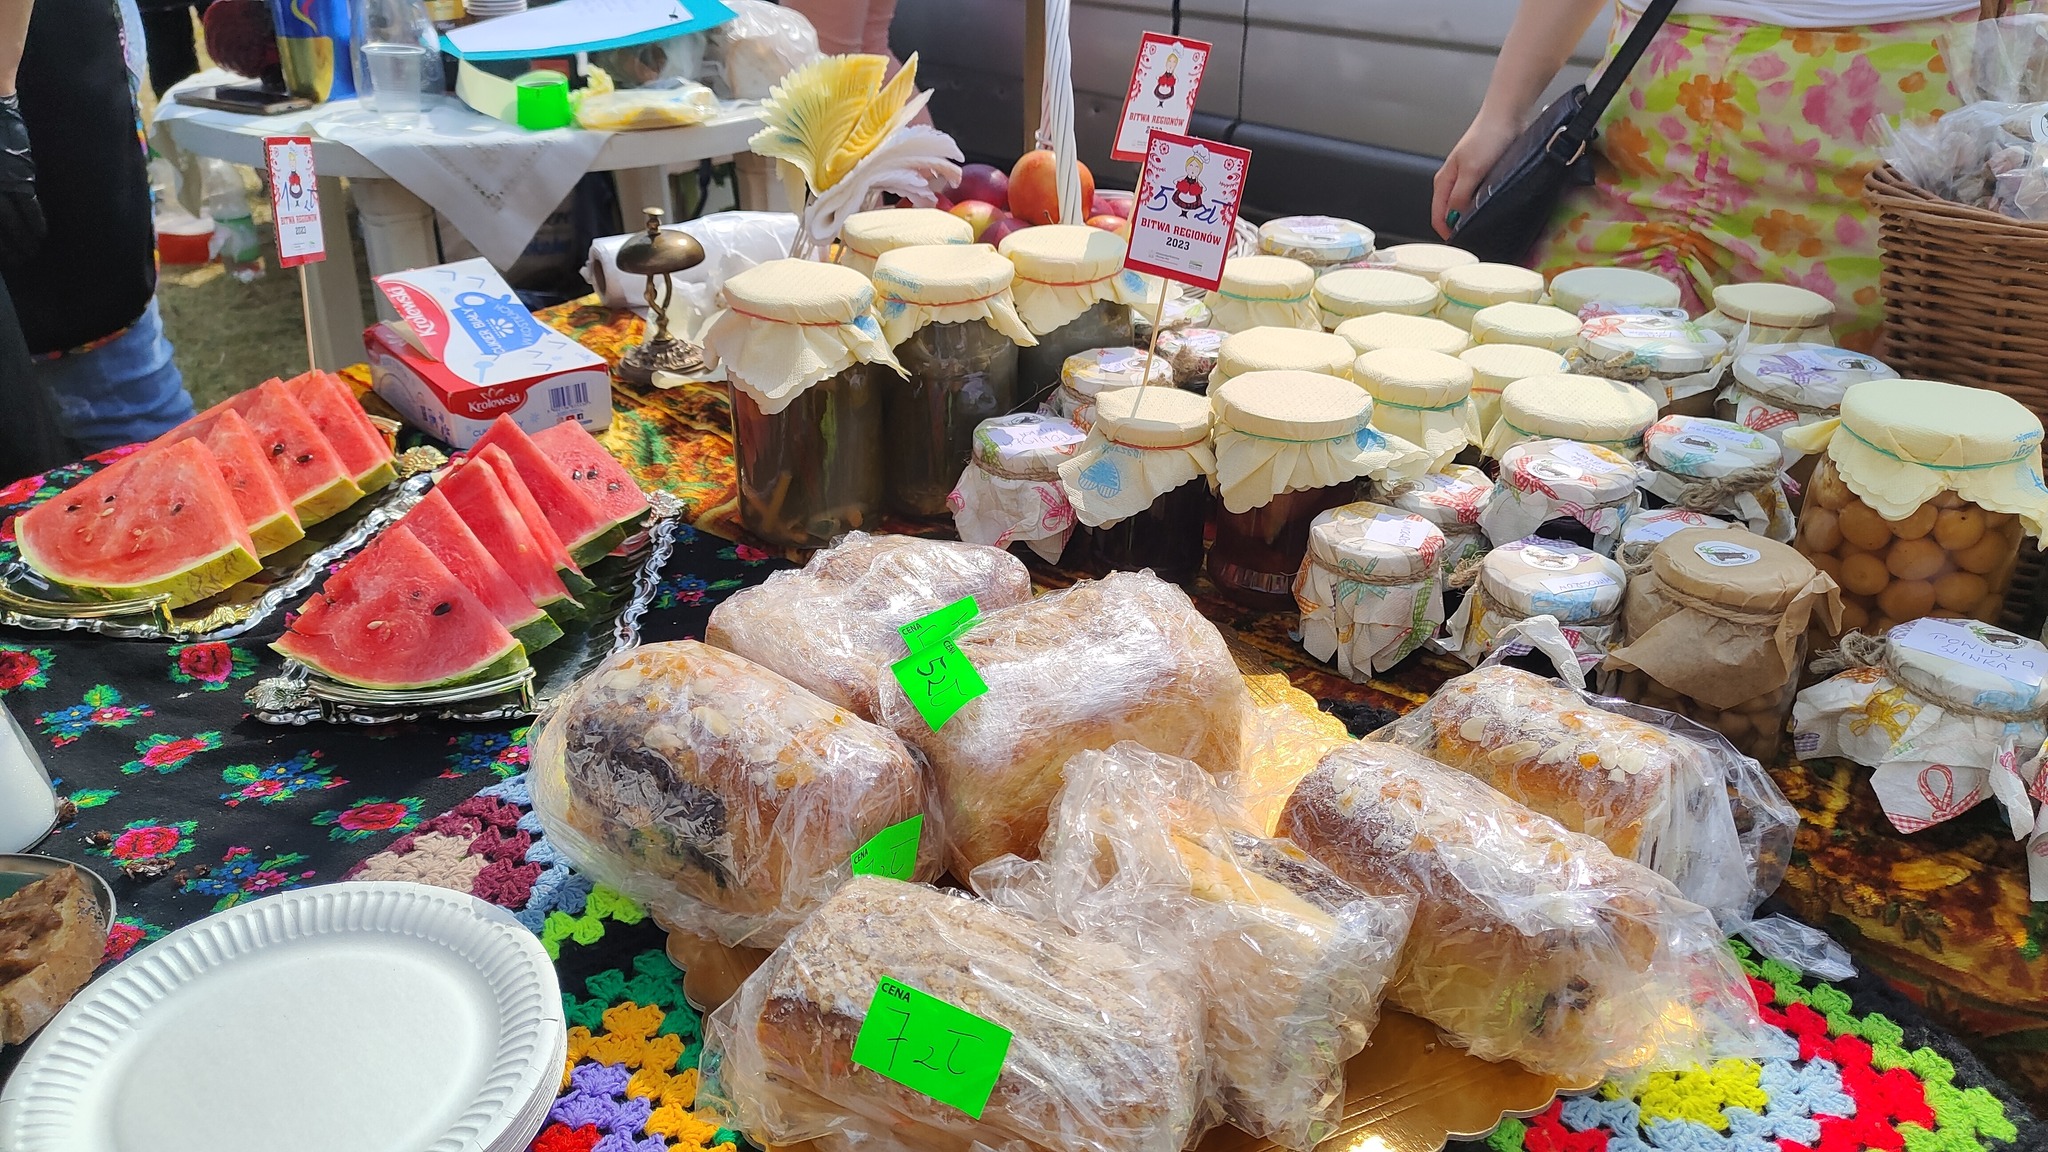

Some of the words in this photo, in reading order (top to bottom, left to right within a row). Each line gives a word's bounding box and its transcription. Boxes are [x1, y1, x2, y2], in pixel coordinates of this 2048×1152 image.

[1129, 112, 1150, 123] BITWA
[1146, 185, 1175, 211] 5
[1140, 217, 1170, 233] BITWA
[1173, 225, 1222, 246] REGIONÓW
[1165, 236, 1190, 251] 2023
[461, 307, 486, 329] BIAŁY
[478, 329, 506, 354] CUKIER
[901, 622, 923, 636] CENA
[853, 848, 869, 865] CENA
[881, 982, 911, 1003] CENA
[886, 1006, 911, 1072] 7
